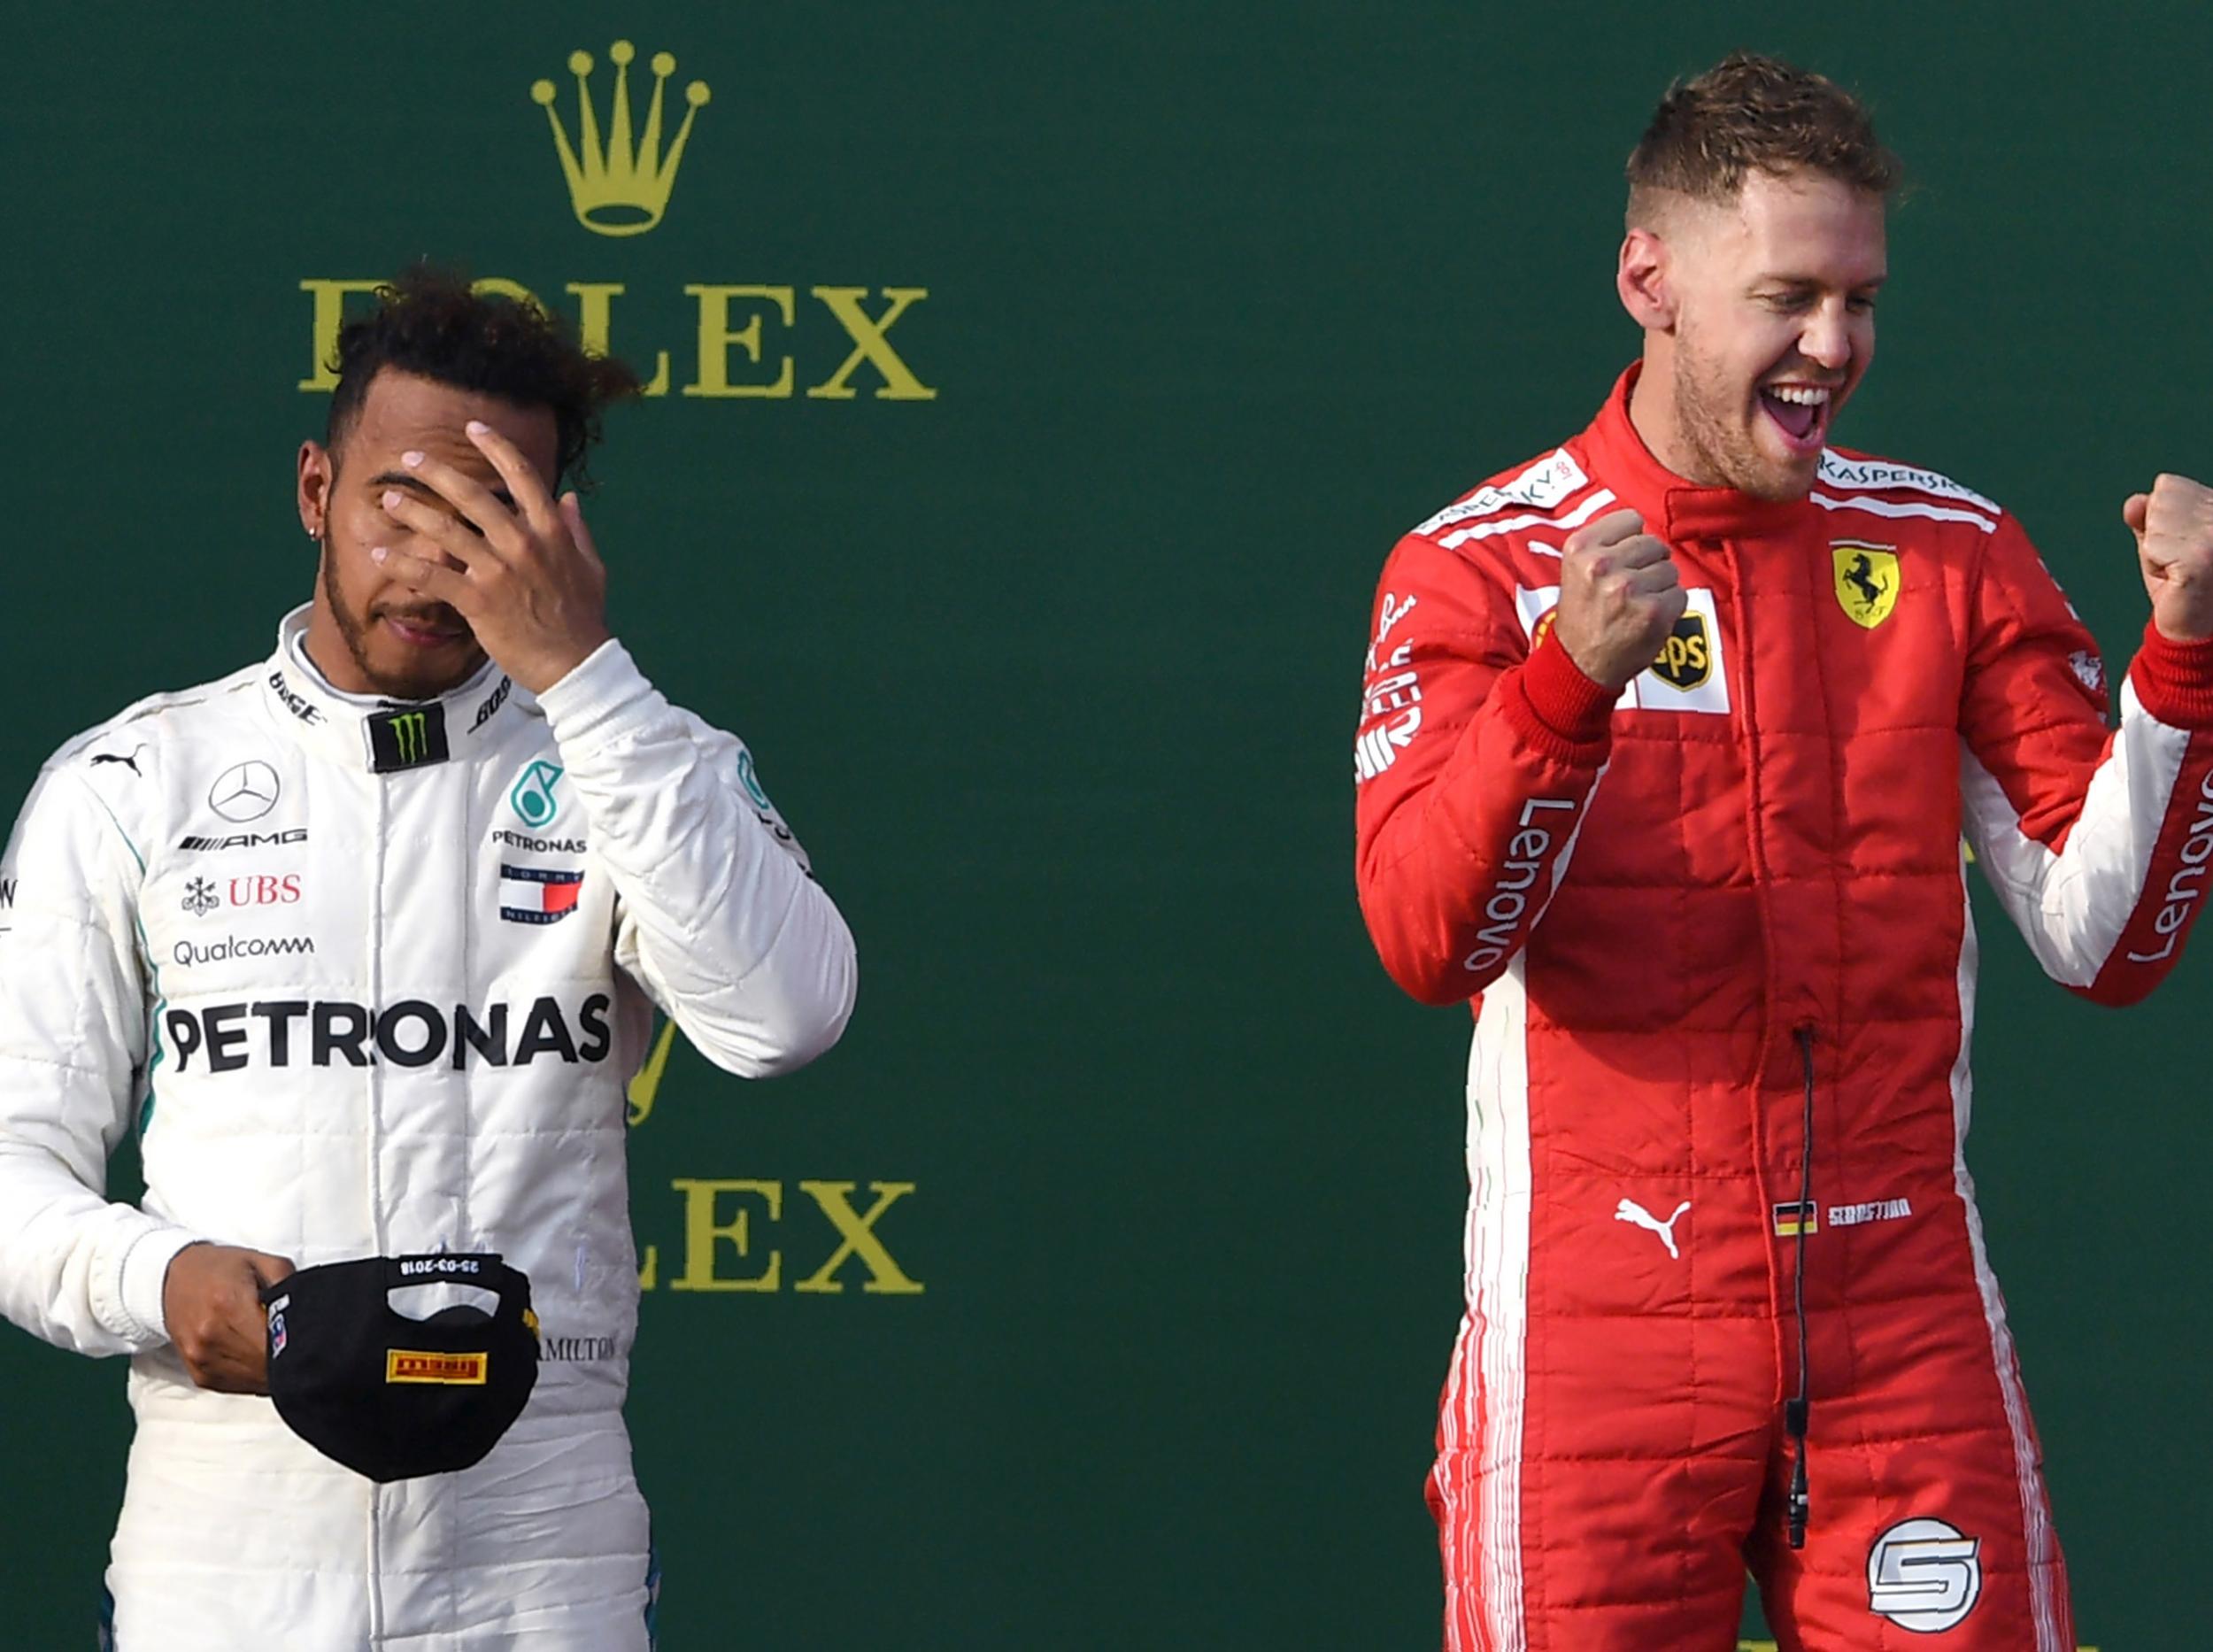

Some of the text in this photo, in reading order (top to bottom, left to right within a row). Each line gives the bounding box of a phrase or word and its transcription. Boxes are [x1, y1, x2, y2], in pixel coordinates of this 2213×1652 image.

[298, 279, 937, 400] RLEX
[221, 828, 308, 850] AMG
[492, 830, 588, 854] PETRONAS
[2127, 768, 2213, 963] Lenov
[228, 874, 302, 907] UBS
[1463, 799, 1575, 971] Lenovo
[173, 935, 315, 968] Qualcomm
[166, 992, 611, 1074] PETRONAS
[401, 1257, 480, 1277] 25-03-2018
[534, 1337, 619, 1363] MILTON
